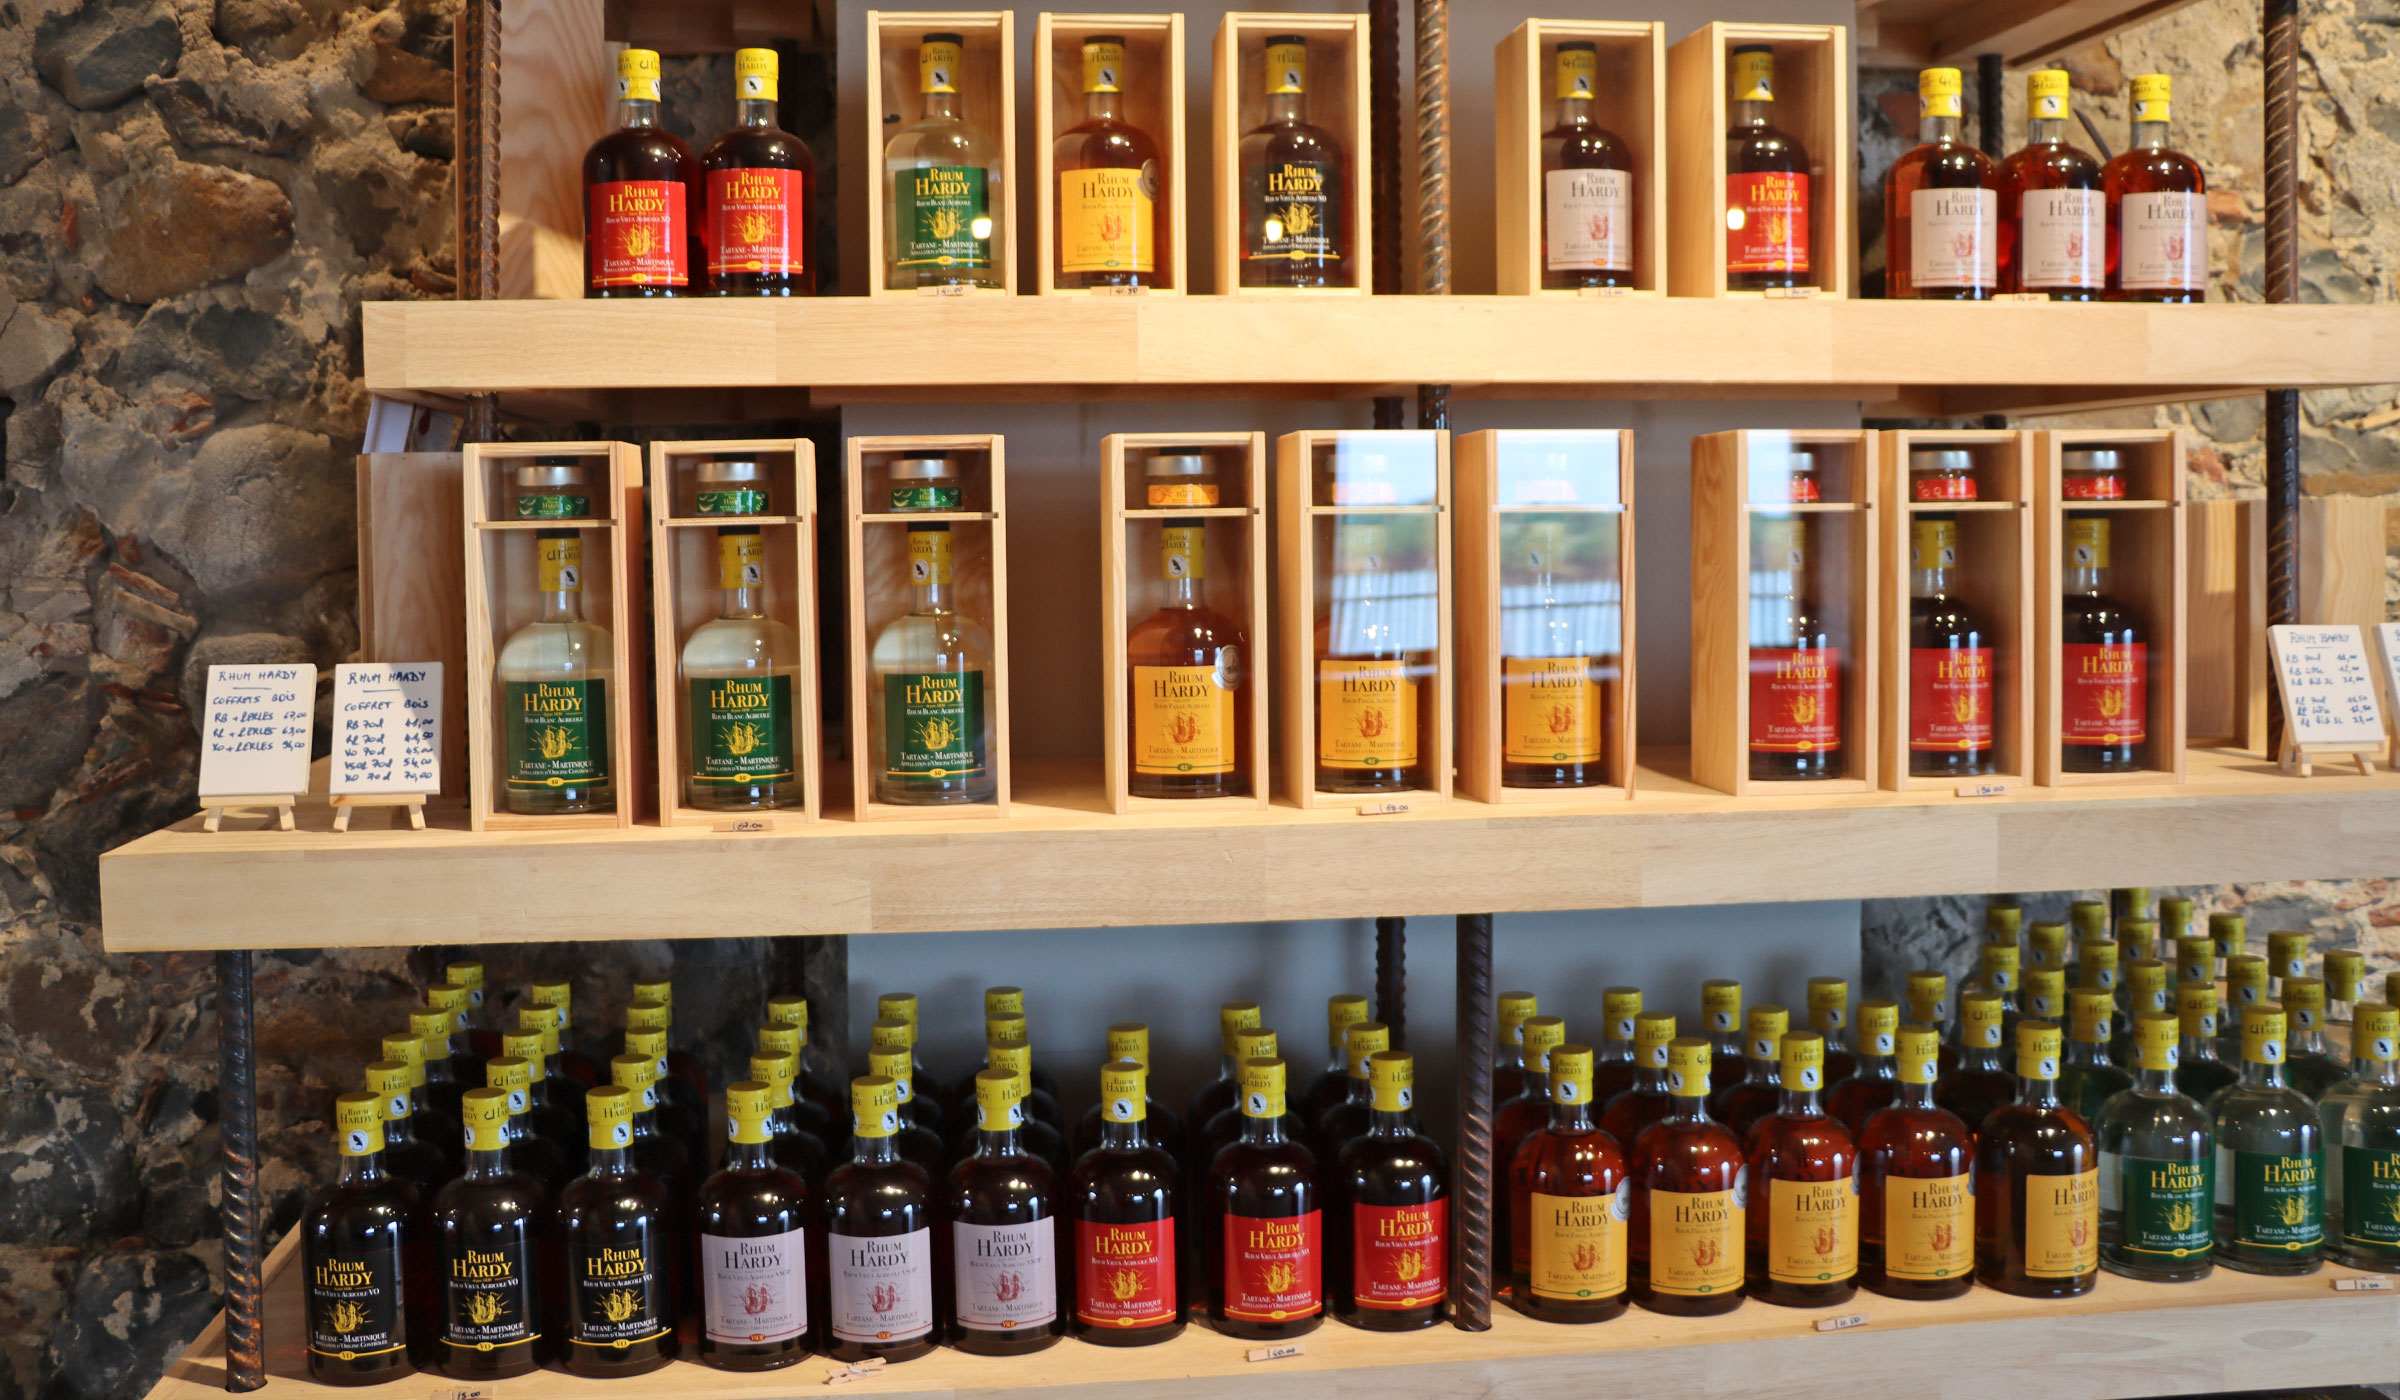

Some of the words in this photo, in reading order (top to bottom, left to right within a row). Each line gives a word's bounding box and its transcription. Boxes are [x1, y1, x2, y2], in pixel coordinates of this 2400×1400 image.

[931, 168, 963, 180] RHUM
[1284, 164, 1316, 177] RHUM
[741, 172, 774, 184] RHUM
[1098, 173, 1129, 184] RHUM
[1269, 173, 1322, 191] HARDY
[1766, 176, 1794, 188] RHUM
[624, 185, 658, 198] RHUM
[727, 182, 780, 199] HARDY
[916, 179, 970, 195] HARDY
[1083, 184, 1134, 198] HARDY
[1572, 182, 1620, 198] HARDY
[1752, 185, 1799, 201] HARDY
[610, 195, 664, 212] HARDY
[1793, 652, 1824, 666] RHUM
[2082, 657, 2134, 674] HARDY
[218, 672, 251, 681] RHUM
[259, 671, 296, 680] HARDY
[1169, 671, 1205, 683] RHUM
[1776, 662, 1830, 680] HARDY
[1939, 661, 1986, 680] HARDY
[347, 673, 381, 684] RHUM
[389, 672, 425, 682] HARDY
[922, 676, 957, 688] RHUM
[1343, 675, 1397, 692] HARDY
[540, 684, 574, 696] RHUM
[727, 680, 762, 693] RHUM
[1154, 680, 1210, 698] HARDY
[712, 690, 769, 708] HARDY
[906, 685, 963, 704] HARDY
[525, 693, 582, 712] HARDY
[553, 759, 593, 769] MARTINIQUE
[739, 755, 780, 765] MARTINIQUE
[2168, 1163, 2199, 1175] RHUM
[2281, 1157, 2312, 1169] RHUM
[2151, 1171, 2204, 1189] HARDY
[2265, 1165, 2316, 1183] HARDY
[1812, 1186, 1843, 1197] RHUM
[1929, 1183, 1960, 1194] RHUM
[1572, 1201, 1605, 1213] RHUM
[1691, 1197, 1725, 1209] RHUM
[1797, 1194, 1847, 1212] HARDY
[1912, 1191, 1963, 1209] HARDY
[1396, 1210, 1430, 1222] RHUM
[1556, 1209, 1610, 1228] HARDY
[1675, 1205, 1729, 1223] HARDY
[1110, 1228, 1146, 1242] RHUM
[1266, 1222, 1300, 1234] RHUM
[1380, 1219, 1434, 1237] HARDY
[993, 1230, 1027, 1243] RHUM
[1249, 1231, 1305, 1249] HARDY
[740, 1242, 775, 1256] RHUM
[867, 1240, 902, 1253] RHUM
[977, 1238, 1033, 1258] HARDY
[1096, 1236, 1152, 1255] HARDY
[467, 1250, 504, 1264] RHUM
[603, 1248, 640, 1262] RHUM
[725, 1251, 782, 1270] HARDY
[850, 1248, 908, 1269] HARDY
[329, 1258, 365, 1272] RHUM
[453, 1258, 512, 1278] HARDY
[587, 1257, 647, 1277] HARDY
[316, 1266, 372, 1287] HARDY
[481, 1322, 524, 1333] MARTINIQUE
[343, 1332, 387, 1342] MARTINIQUE
